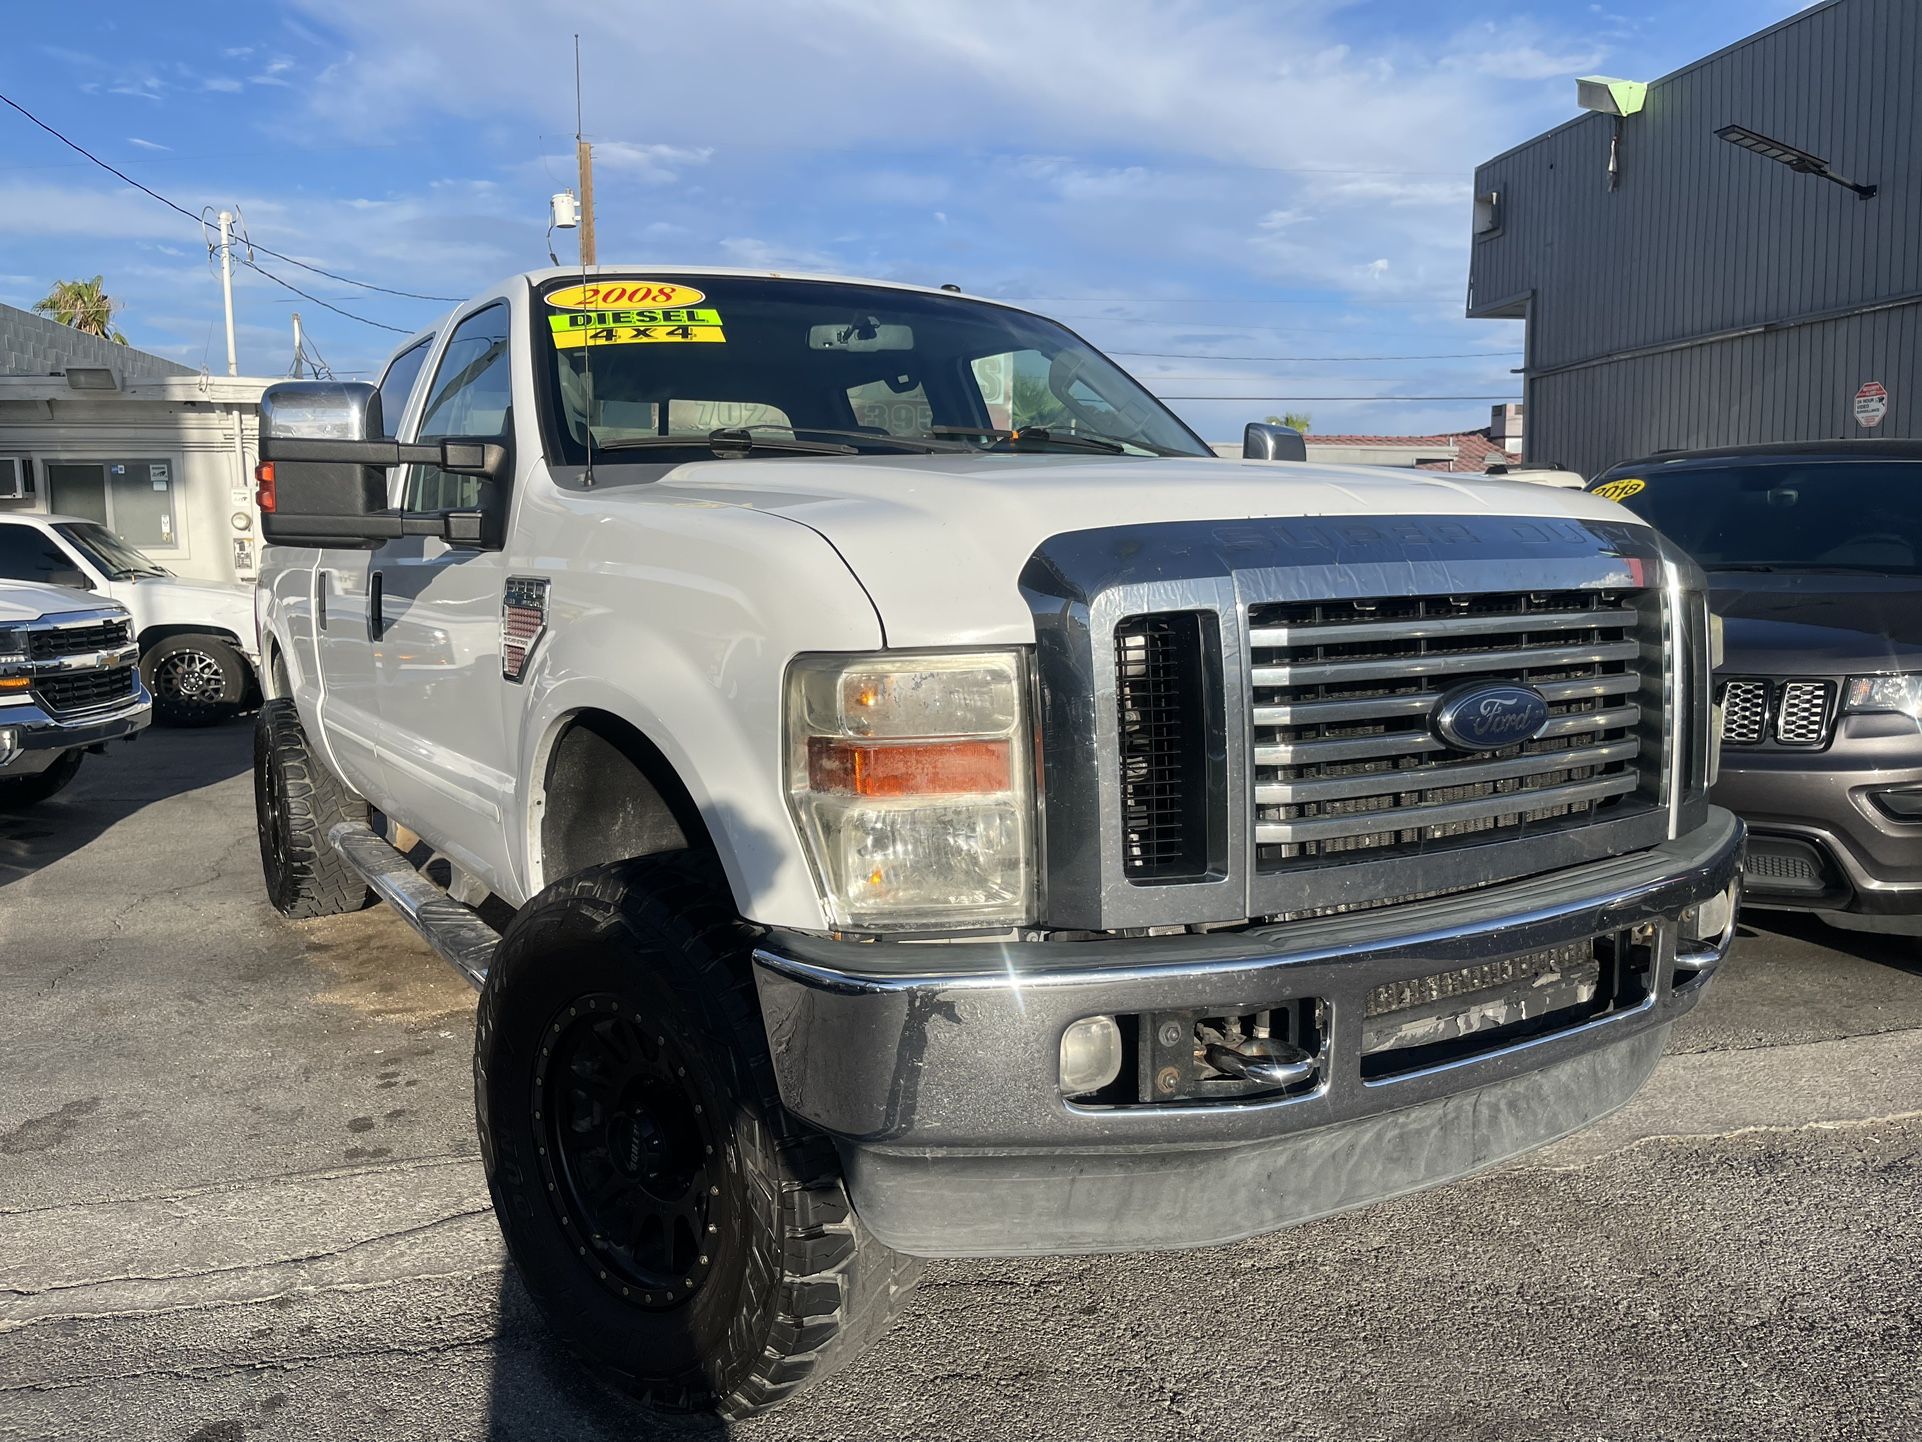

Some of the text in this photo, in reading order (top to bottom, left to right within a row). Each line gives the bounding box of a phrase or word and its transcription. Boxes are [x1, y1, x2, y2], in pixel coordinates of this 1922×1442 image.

[573, 286, 677, 306] 2008
[568, 310, 709, 328] DIESEL
[1212, 521, 1484, 550] SUPER
[1473, 698, 1532, 736] Ford
